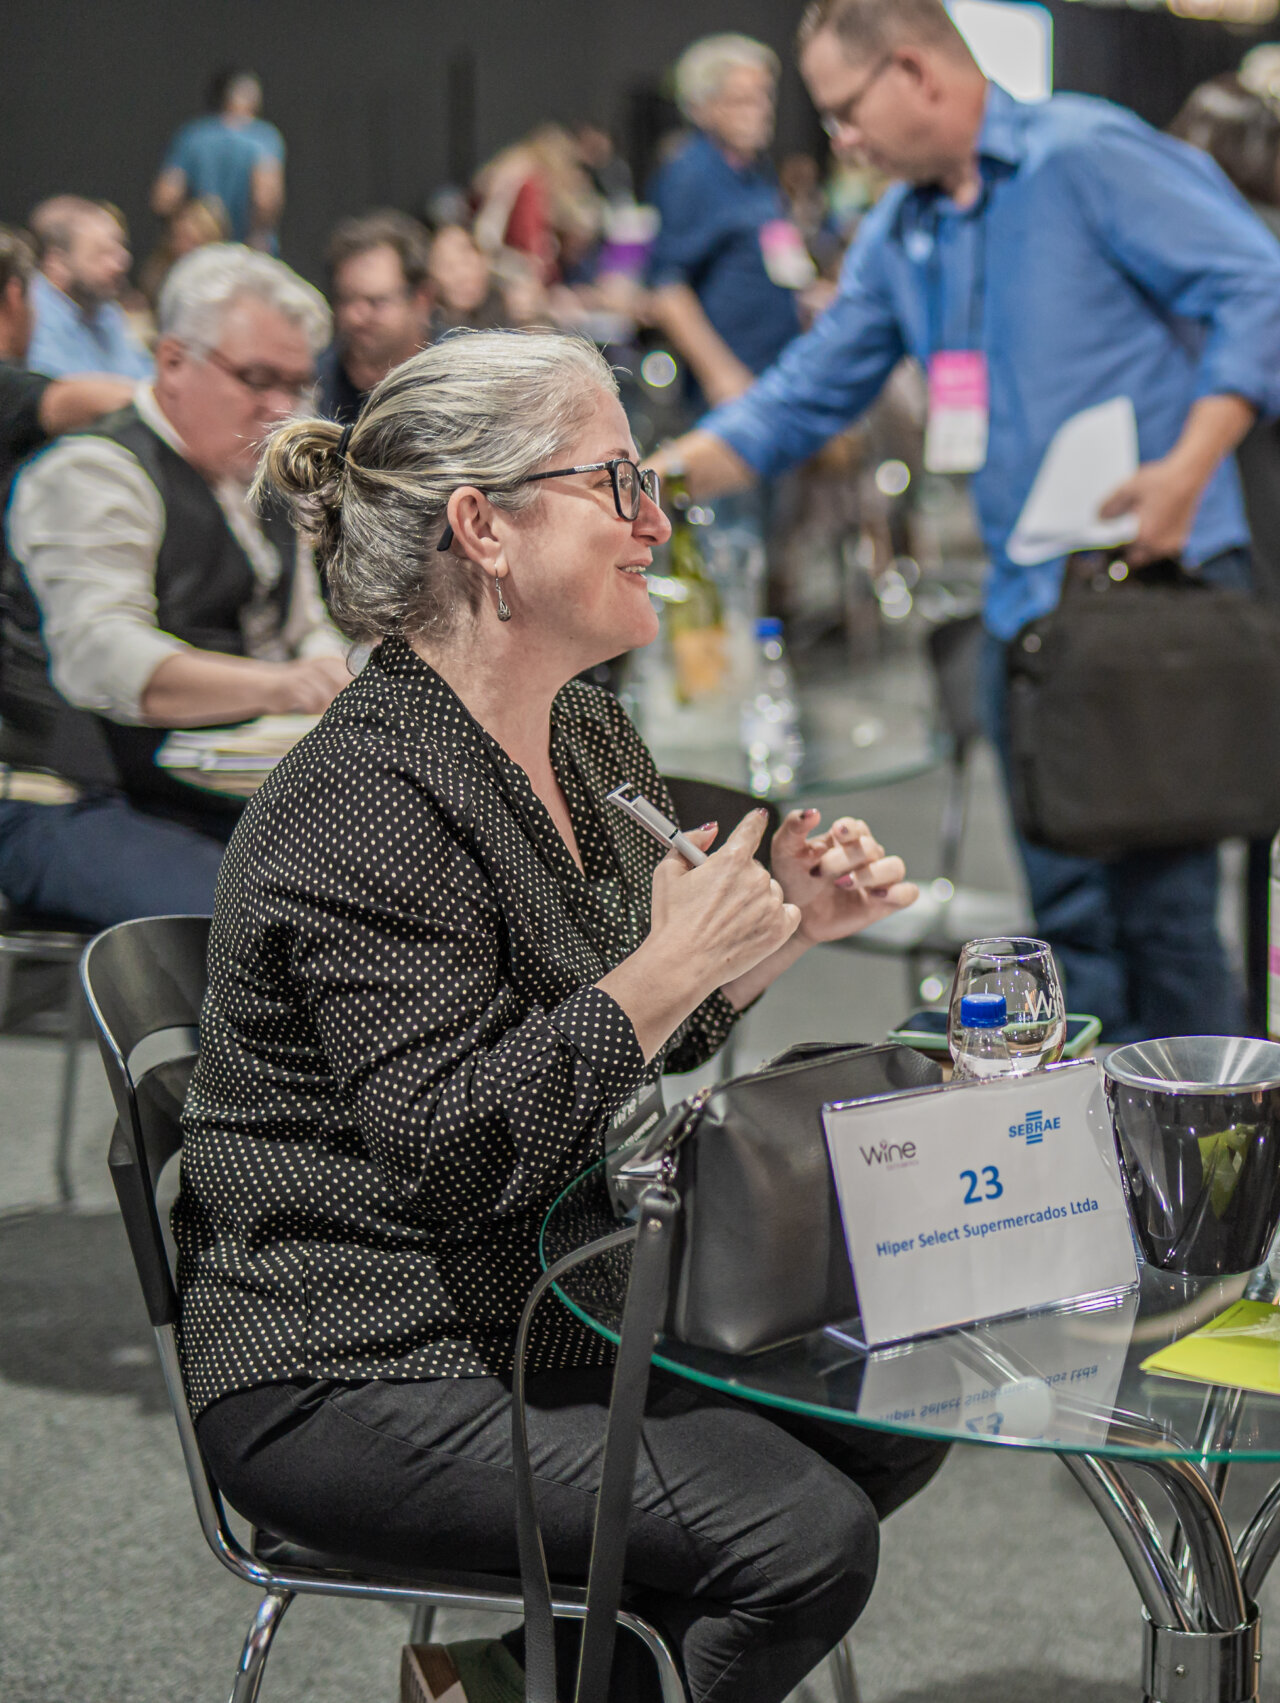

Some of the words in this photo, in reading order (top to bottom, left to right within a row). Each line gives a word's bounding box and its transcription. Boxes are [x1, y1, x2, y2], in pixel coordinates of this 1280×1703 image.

[1008, 1117, 1061, 1138] SEBRAE
[859, 1139, 917, 1167] Wine
[959, 1165, 1004, 1205] 23
[876, 1238, 915, 1257] Hiper
[918, 1228, 960, 1248] Select
[963, 1206, 1068, 1238] Supermercados
[1070, 1198, 1100, 1215] Ltda
